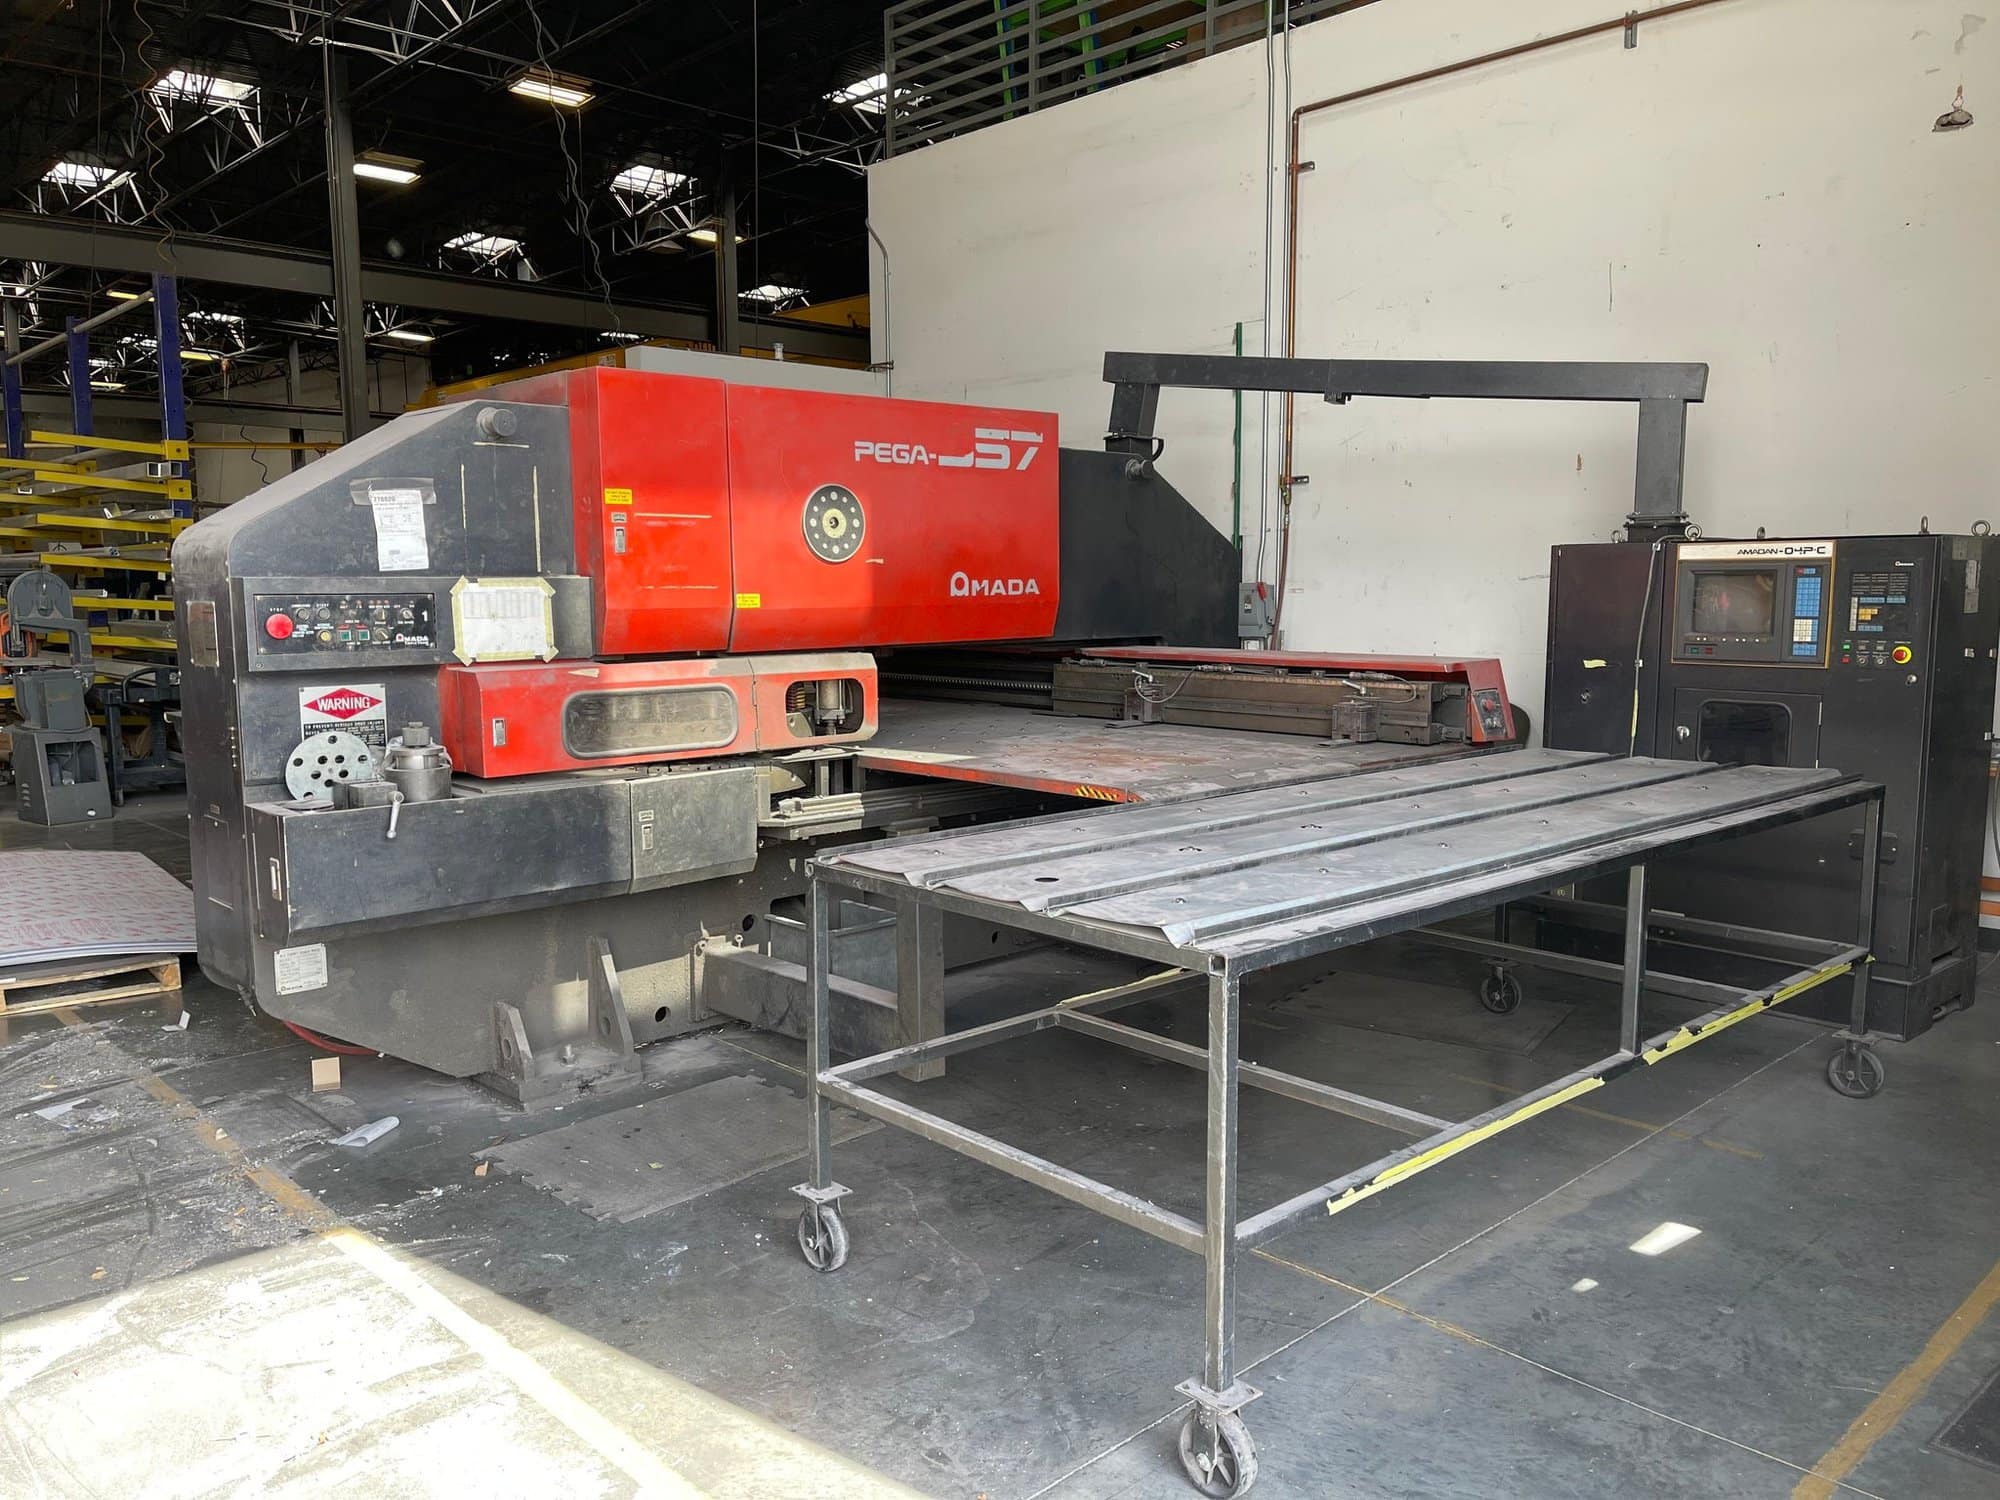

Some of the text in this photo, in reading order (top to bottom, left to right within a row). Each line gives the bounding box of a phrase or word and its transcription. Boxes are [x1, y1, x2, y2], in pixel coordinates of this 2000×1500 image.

[950, 571, 1041, 597] AMADA
[421, 610, 428, 622] 1
[316, 696, 370, 711] WARNING
